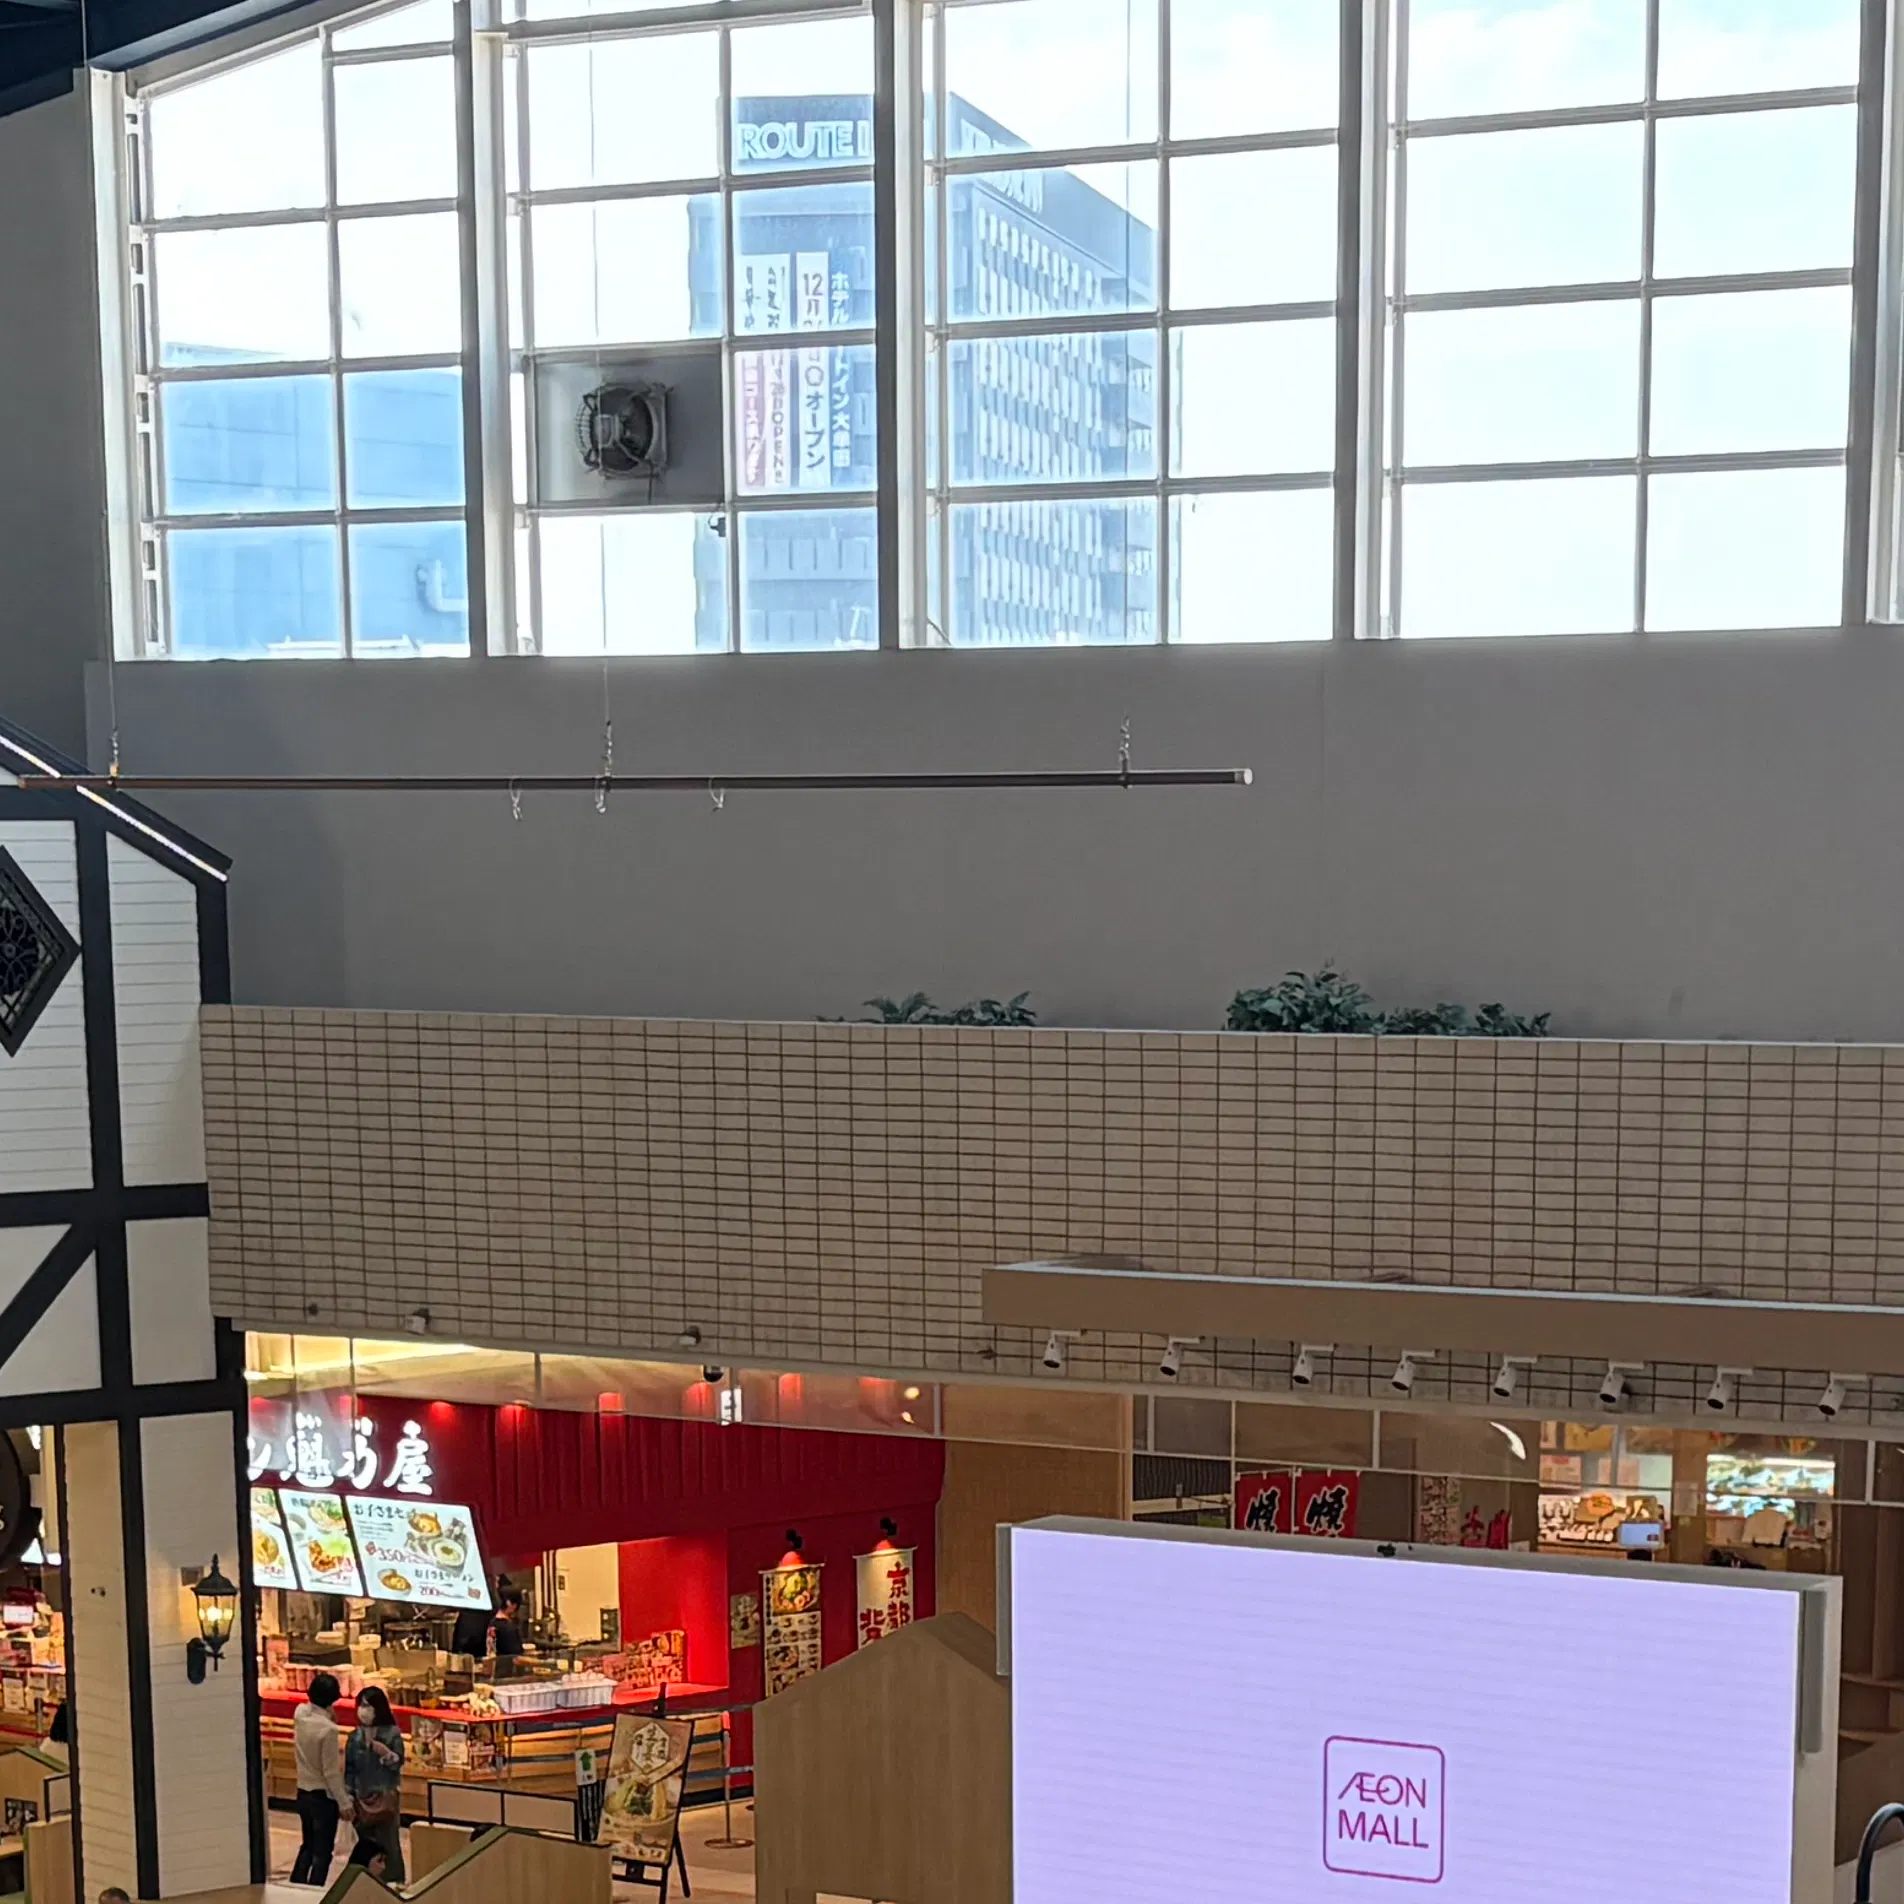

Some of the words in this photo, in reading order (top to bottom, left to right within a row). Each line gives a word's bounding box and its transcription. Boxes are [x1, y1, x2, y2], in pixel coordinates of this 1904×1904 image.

[738, 120, 855, 160] ROUTE
[887, 1561, 911, 1630] 京都
[1338, 1808, 1430, 1849] MALL
